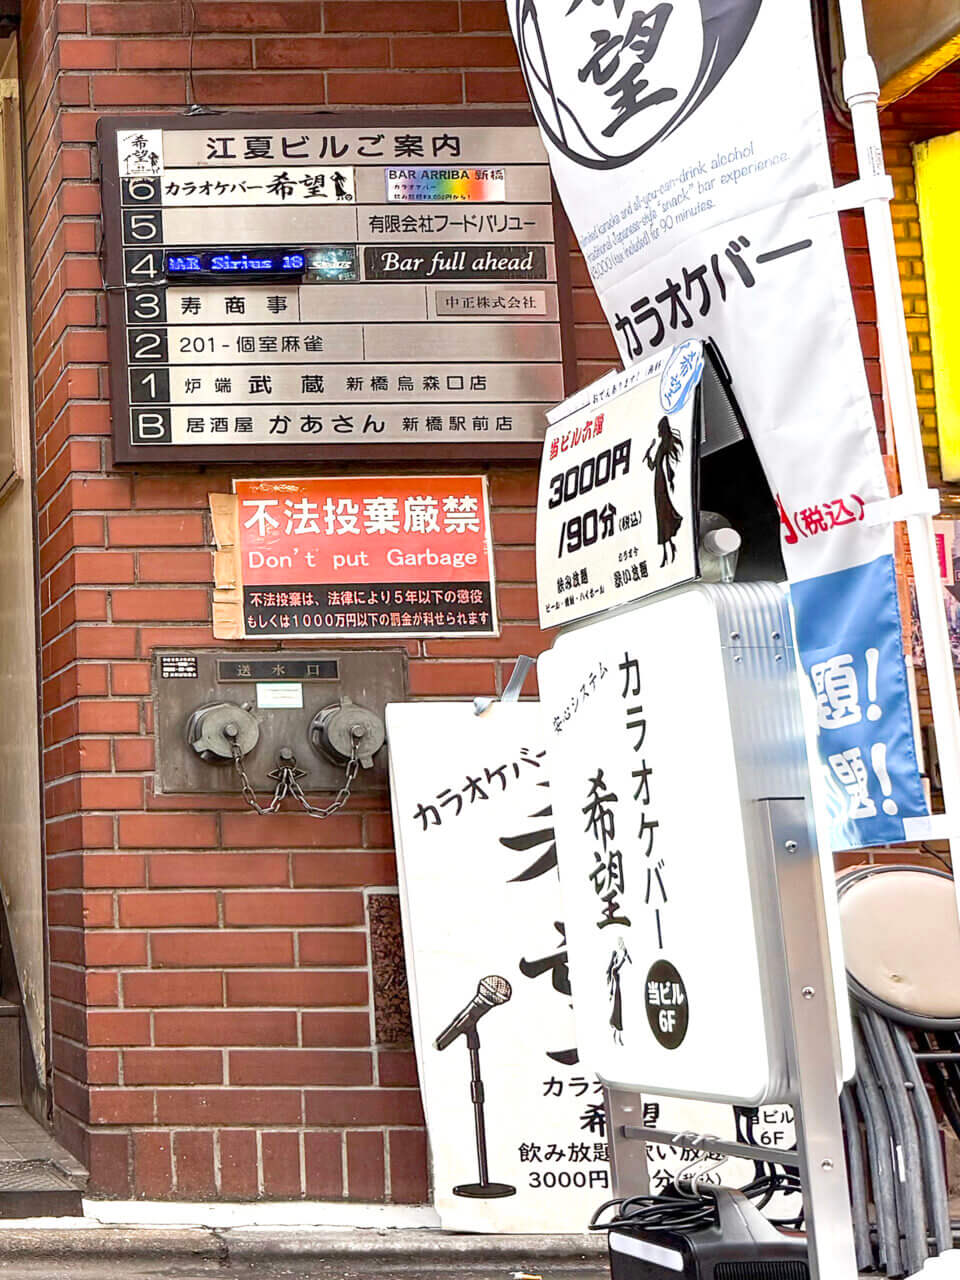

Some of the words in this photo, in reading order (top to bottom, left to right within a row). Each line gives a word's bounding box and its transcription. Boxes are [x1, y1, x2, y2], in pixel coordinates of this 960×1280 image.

[206, 134, 461, 161] 江夏ビルご案内
[710, 140, 754, 170] alcohol
[388, 169, 417, 180] BAR
[420, 169, 470, 180] ARRIBA
[474, 169, 504, 181] 新橋
[696, 177, 717, 195] bar
[128, 176, 155, 201] 6
[130, 214, 157, 240] 5
[130, 253, 158, 279] 4
[211, 254, 273, 270] Sirius
[380, 251, 424, 271] Bar
[425, 250, 466, 276] full
[471, 251, 534, 271] ahead
[134, 293, 160, 318] 3
[445, 295, 537, 310] 中正株式会社
[613, 235, 813, 361] カラオケバー
[135, 333, 161, 359] 2
[141, 372, 156, 399] 1
[184, 377, 232, 394] 炉端
[137, 413, 166, 439] B
[186, 416, 254, 433] 居酒屋
[269, 414, 385, 434] かあさん
[402, 415, 513, 432] 新橋駅前店
[547, 437, 632, 510] 3000円
[242, 494, 481, 537] 不法投棄厳禁
[774, 492, 867, 545] (税込)
[248, 547, 316, 569] Don't
[332, 551, 369, 570] put
[386, 548, 478, 568] Garbage
[236, 664, 320, 677] 送水口
[618, 650, 668, 951] カラオケバー
[582, 767, 632, 931] 希望
[646, 979, 685, 1007] 当ビル
[658, 1008, 677, 1033] 6F
[760, 1130, 785, 1145] 6F
